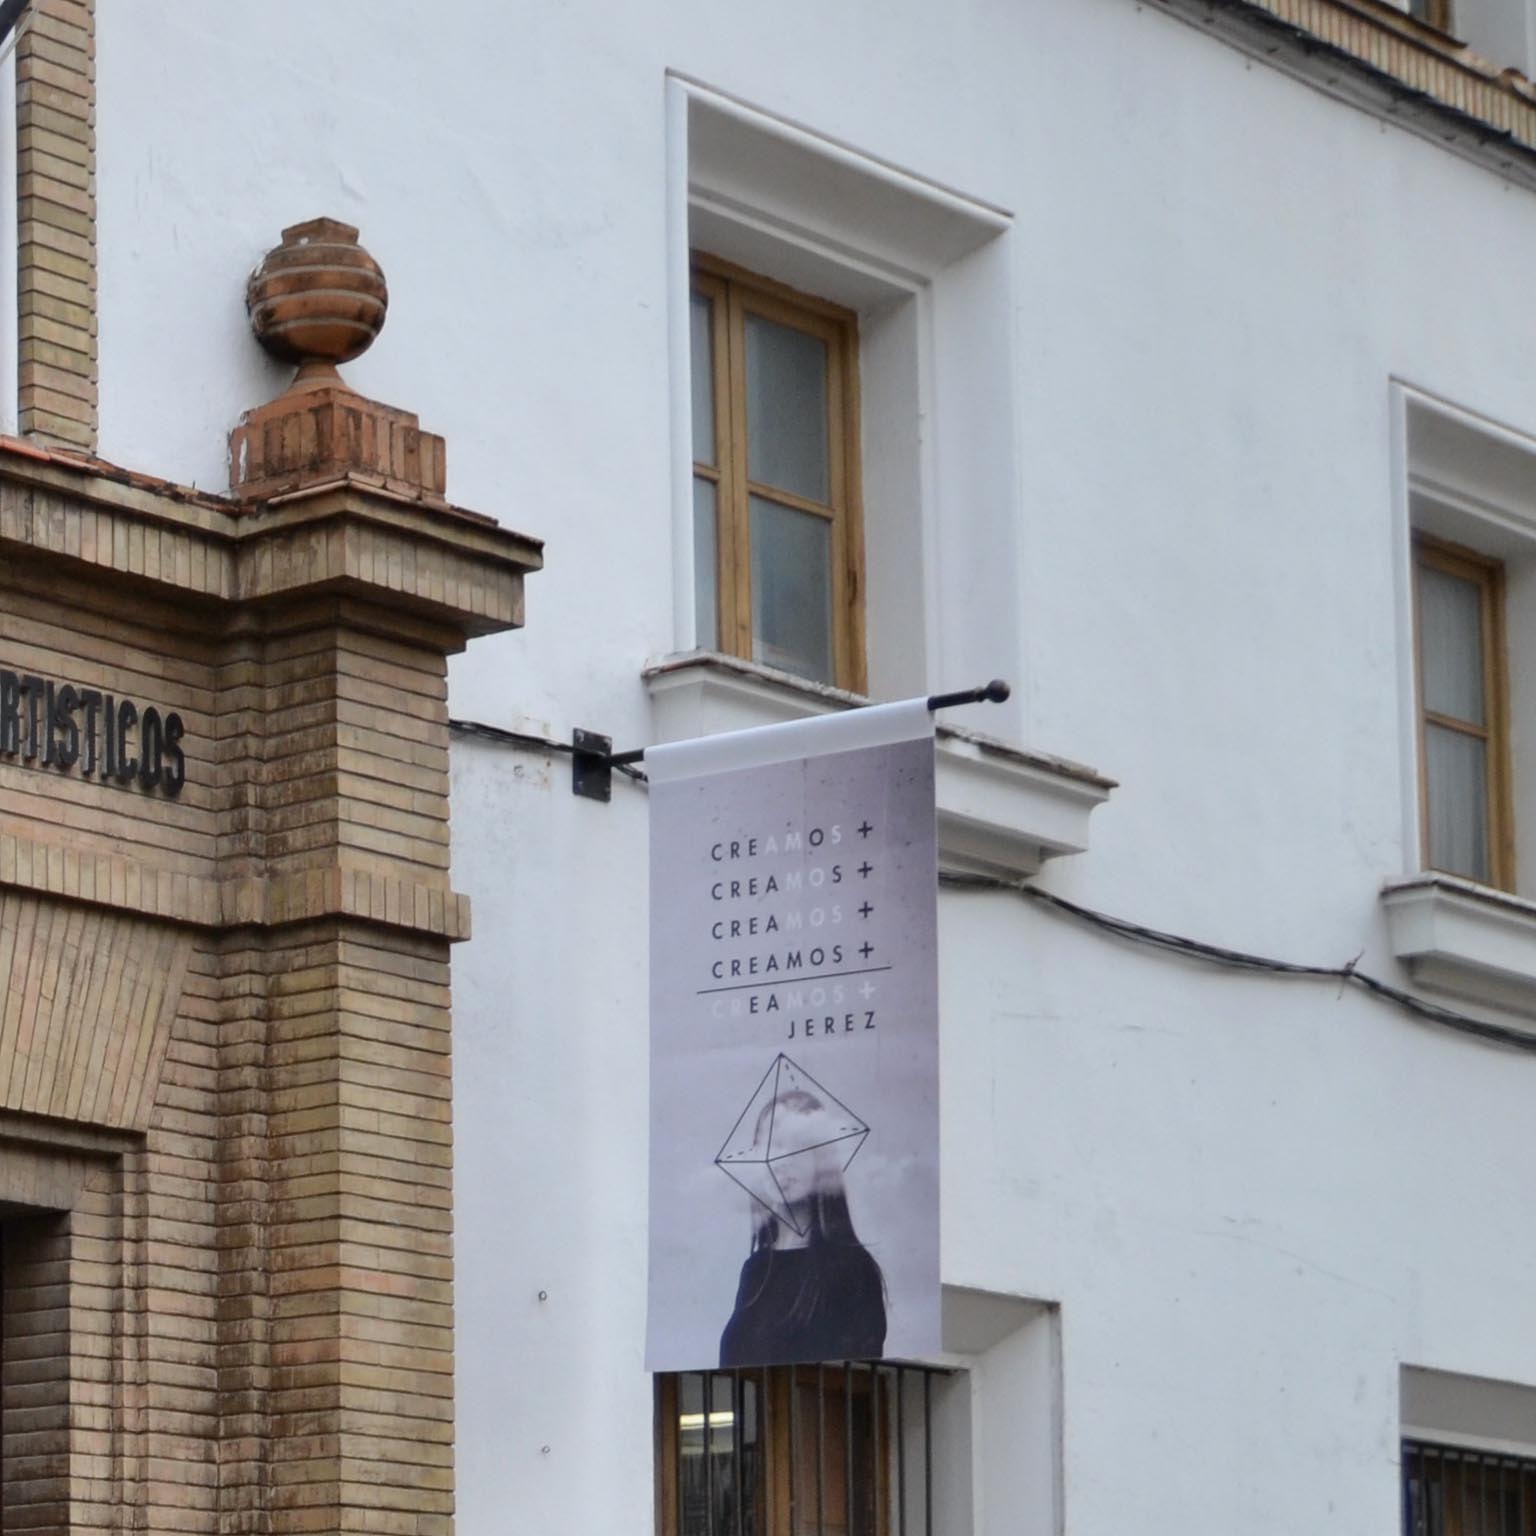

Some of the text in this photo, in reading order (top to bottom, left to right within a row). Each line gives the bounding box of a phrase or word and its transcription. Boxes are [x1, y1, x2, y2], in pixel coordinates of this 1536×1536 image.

[711, 824, 842, 861] CREAMOS
[711, 864, 842, 901] CREAMOS
[711, 904, 842, 940] CREAMOS
[712, 944, 843, 979] CREAMOS
[787, 1010, 877, 1039] JEREZ
